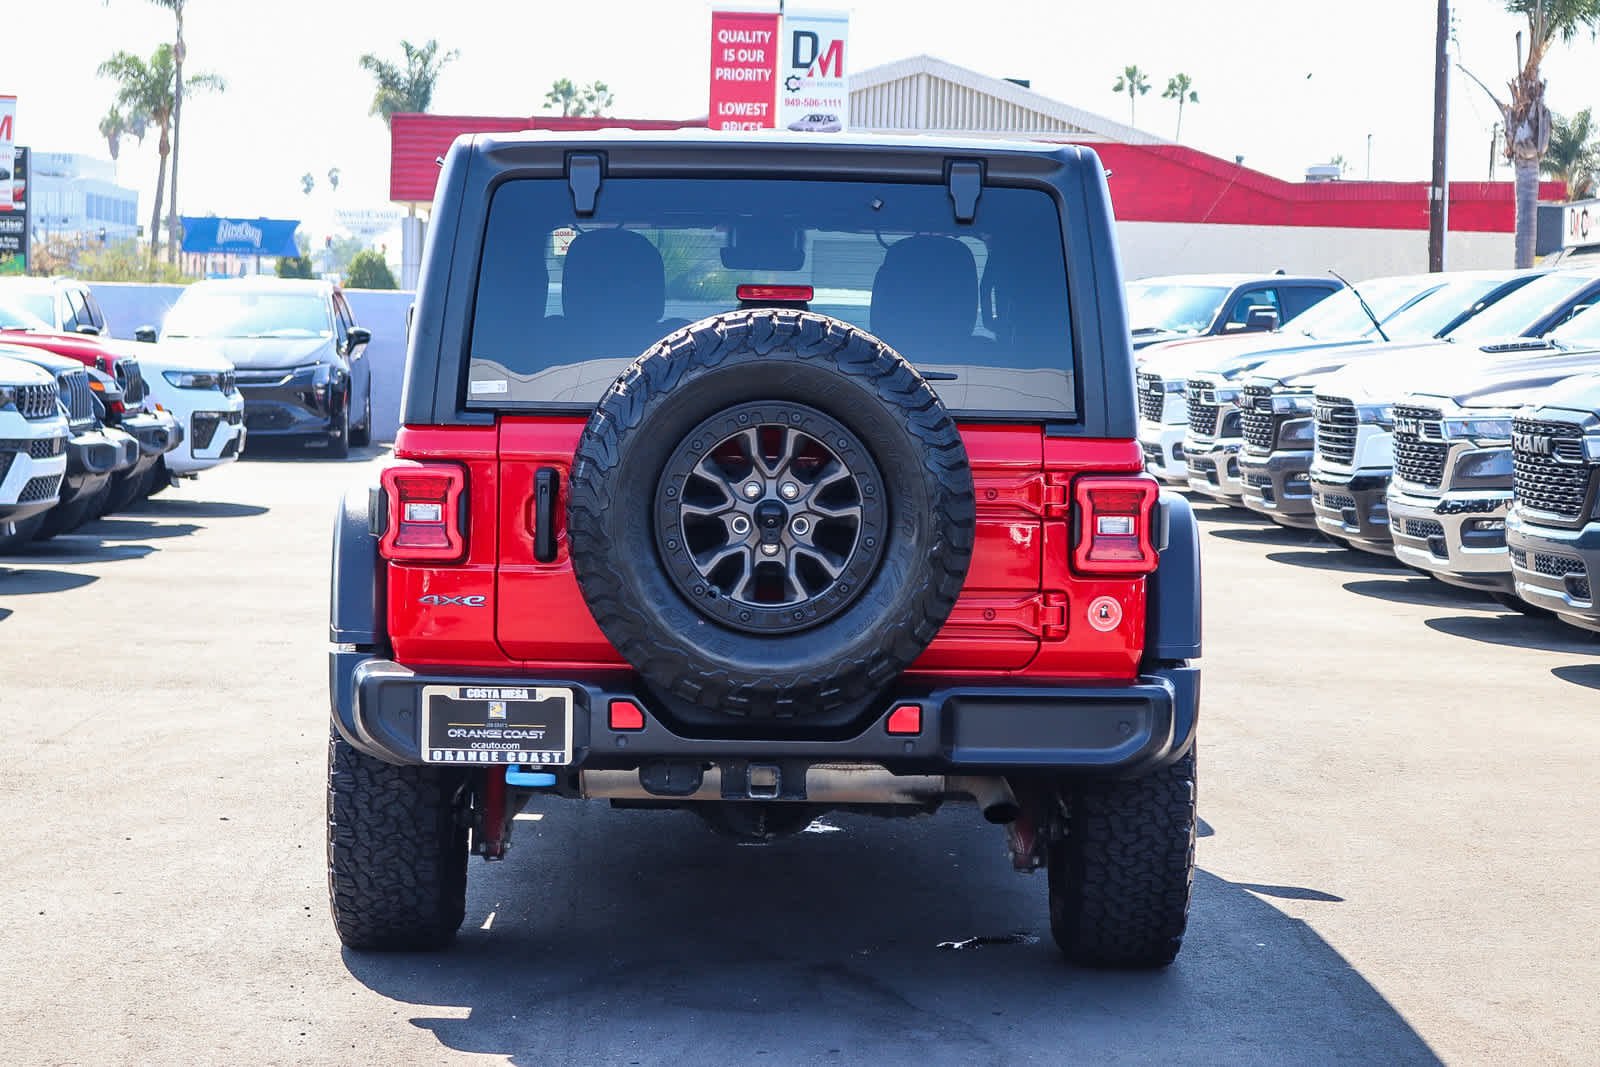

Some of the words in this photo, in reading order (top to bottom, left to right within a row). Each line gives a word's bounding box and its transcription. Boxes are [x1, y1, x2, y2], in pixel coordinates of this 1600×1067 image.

[718, 30, 771, 44] QUALITY
[724, 49, 736, 62] IS
[738, 49, 764, 63] OUR
[715, 68, 772, 82] PRIORITY
[719, 102, 768, 117] LOWEST
[1512, 432, 1552, 455] RAM
[466, 689, 500, 699] COSTA
[501, 690, 528, 699] MESA
[447, 728, 502, 739] ORANGE
[502, 730, 545, 739] COAST
[471, 742, 520, 750] ocauto.com
[432, 751, 499, 761] ORANGE
[506, 752, 562, 762] COAST
